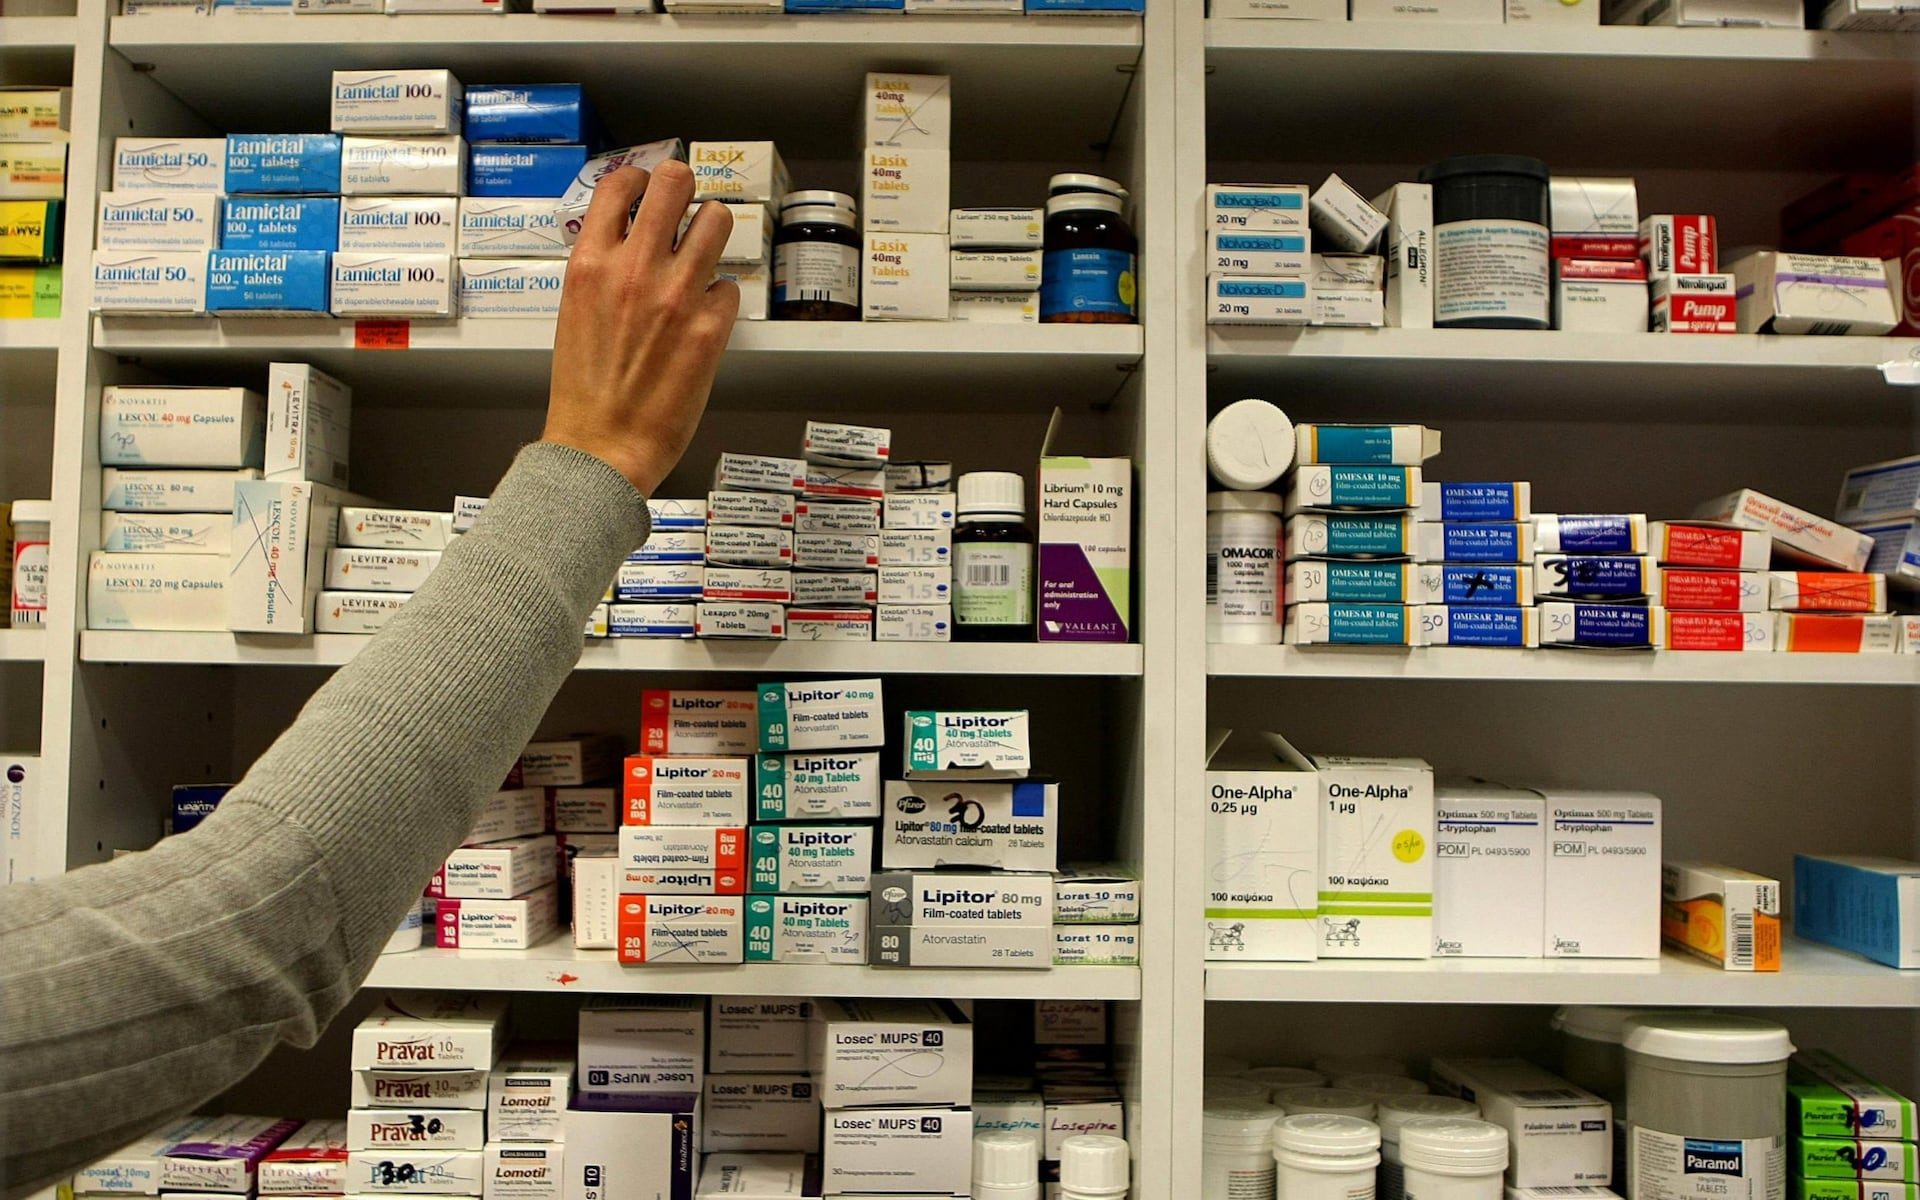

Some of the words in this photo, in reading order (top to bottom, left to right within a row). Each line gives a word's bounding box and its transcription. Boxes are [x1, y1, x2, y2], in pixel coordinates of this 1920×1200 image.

[336, 84, 400, 99] Lamictal
[405, 84, 432, 98] 100
[228, 138, 304, 155] Lamictal
[696, 145, 745, 162] Lasix
[119, 153, 182, 166] Lamictal
[187, 153, 208, 167] 50
[871, 155, 908, 167] Lasix
[696, 166, 733, 179] 20mg
[872, 168, 901, 179] 40mg
[696, 179, 743, 192] Tablets
[871, 180, 910, 191] Tablets
[1217, 195, 1282, 207] Nolvadex-D
[1216, 215, 1230, 224] 20
[1231, 217, 1247, 226] mg
[1656, 223, 1671, 272] Nitrolingual
[1681, 226, 1698, 268] Pump
[1418, 230, 1427, 283] ALLEGRON
[211, 255, 286, 271] Lamictal
[95, 266, 160, 281] Lamictal
[165, 267, 187, 281] 50
[211, 273, 231, 285] 100
[244, 273, 283, 285] tablets
[462, 275, 525, 290] Lamictal
[529, 276, 560, 290] 200
[1677, 278, 1728, 291] Nitrolingual
[1683, 301, 1727, 319] Pump
[119, 398, 167, 406] NOVARTIS
[290, 390, 300, 434] LEVITRA
[118, 413, 159, 422] LESCOL
[162, 414, 174, 422] 40
[176, 415, 191, 425] mg
[193, 414, 235, 424] Capsules
[1335, 473, 1375, 482] OMESAR
[1378, 473, 1387, 482] 10
[1388, 475, 1401, 483] mg
[1092, 484, 1104, 494] 10
[1106, 486, 1123, 497] mg
[1335, 482, 1376, 490] film-coated
[1377, 482, 1401, 490] tablets
[1044, 498, 1070, 509] Hard
[1073, 499, 1118, 511] Capsules
[1449, 529, 1488, 538] OMESAR
[1490, 529, 1499, 538] 20
[1500, 531, 1513, 540] mg
[1084, 545, 1096, 553] 100
[1098, 546, 1127, 554] capsules
[1221, 547, 1275, 560] OMACOR
[351, 555, 395, 565] LEVITRA
[396, 556, 406, 565] 20
[407, 558, 419, 568] mg
[1226, 561, 1243, 569] 1000
[1244, 563, 1256, 571] mg
[1257, 561, 1270, 569] soft
[1233, 570, 1265, 578] capsules
[106, 579, 147, 588] LESCOL
[149, 579, 162, 588] 20
[164, 580, 179, 590] mg
[182, 579, 224, 590] Capsules
[622, 576, 655, 586] Lexapro
[1044, 581, 1057, 589] For
[1058, 580, 1075, 589] oral
[1044, 591, 1099, 600] administration
[266, 580, 278, 625] Capsules
[1044, 601, 1061, 610] only
[703, 608, 738, 619] Lexapro
[747, 610, 770, 620] 20mg
[1579, 609, 1619, 619] OMESAR
[1621, 610, 1631, 619] 40
[1632, 611, 1645, 621] mg
[715, 620, 746, 630] Tablets
[1065, 622, 1118, 632] VALEANT
[789, 689, 841, 703] Lipitor
[845, 690, 860, 699] 40
[862, 690, 875, 700] mg
[672, 698, 723, 710] Lipitor
[945, 716, 1009, 730] Lipitor
[946, 729, 958, 738] 40
[960, 731, 975, 740] mg
[978, 729, 1012, 738] Tablets
[914, 737, 934, 751] 40
[793, 757, 858, 773] Lipitor
[656, 766, 708, 779] Lipitor
[712, 769, 724, 778] 20
[726, 772, 741, 781] mg
[657, 789, 703, 799] Film-coated
[706, 789, 732, 799] tablets
[630, 799, 646, 810] 20
[944, 792, 986, 829] 30
[1211, 802, 1238, 814] 0,25
[1329, 801, 1335, 811] 1
[1437, 809, 1479, 820] Optimax
[1481, 810, 1496, 819] 500
[1497, 812, 1510, 821] mg
[1512, 810, 1538, 820] Tablets
[895, 821, 924, 834] Lipitor
[930, 822, 942, 832] 80
[943, 824, 957, 834] mg
[1013, 823, 1044, 835] tablets
[1437, 823, 1497, 834] L-tryptophan
[788, 832, 852, 847] Lipitor
[895, 834, 953, 846] Atorvastatin
[955, 836, 993, 847] calcium
[1438, 843, 1467, 855] POM
[1471, 847, 1483, 856] PL
[923, 889, 996, 906] Lipitor
[1002, 893, 1019, 904] 80
[1021, 895, 1043, 906] mg
[1211, 893, 1229, 902] 100
[783, 901, 848, 917] Lipitor
[923, 908, 984, 919] Film-coated
[987, 908, 1022, 920] tablets
[462, 913, 495, 923] Lipitor
[881, 936, 899, 949] 80
[922, 933, 987, 945] Atorvastatin
[1056, 934, 1090, 943] Lorat
[1095, 934, 1111, 943] 10
[1114, 935, 1135, 945] mg
[992, 949, 1002, 958] 28
[1004, 949, 1034, 958] Tablets
[836, 1032, 875, 1045] Losec
[880, 1033, 918, 1045] MUPS
[925, 1033, 941, 1045] 40
[377, 1042, 435, 1061] Pravat
[439, 1040, 454, 1052] 10
[500, 1095, 551, 1107] Lomotil
[1687, 1154, 1739, 1171] Paramol
[125, 1168, 150, 1180] 10mg
[99, 1179, 133, 1189] Tablets
